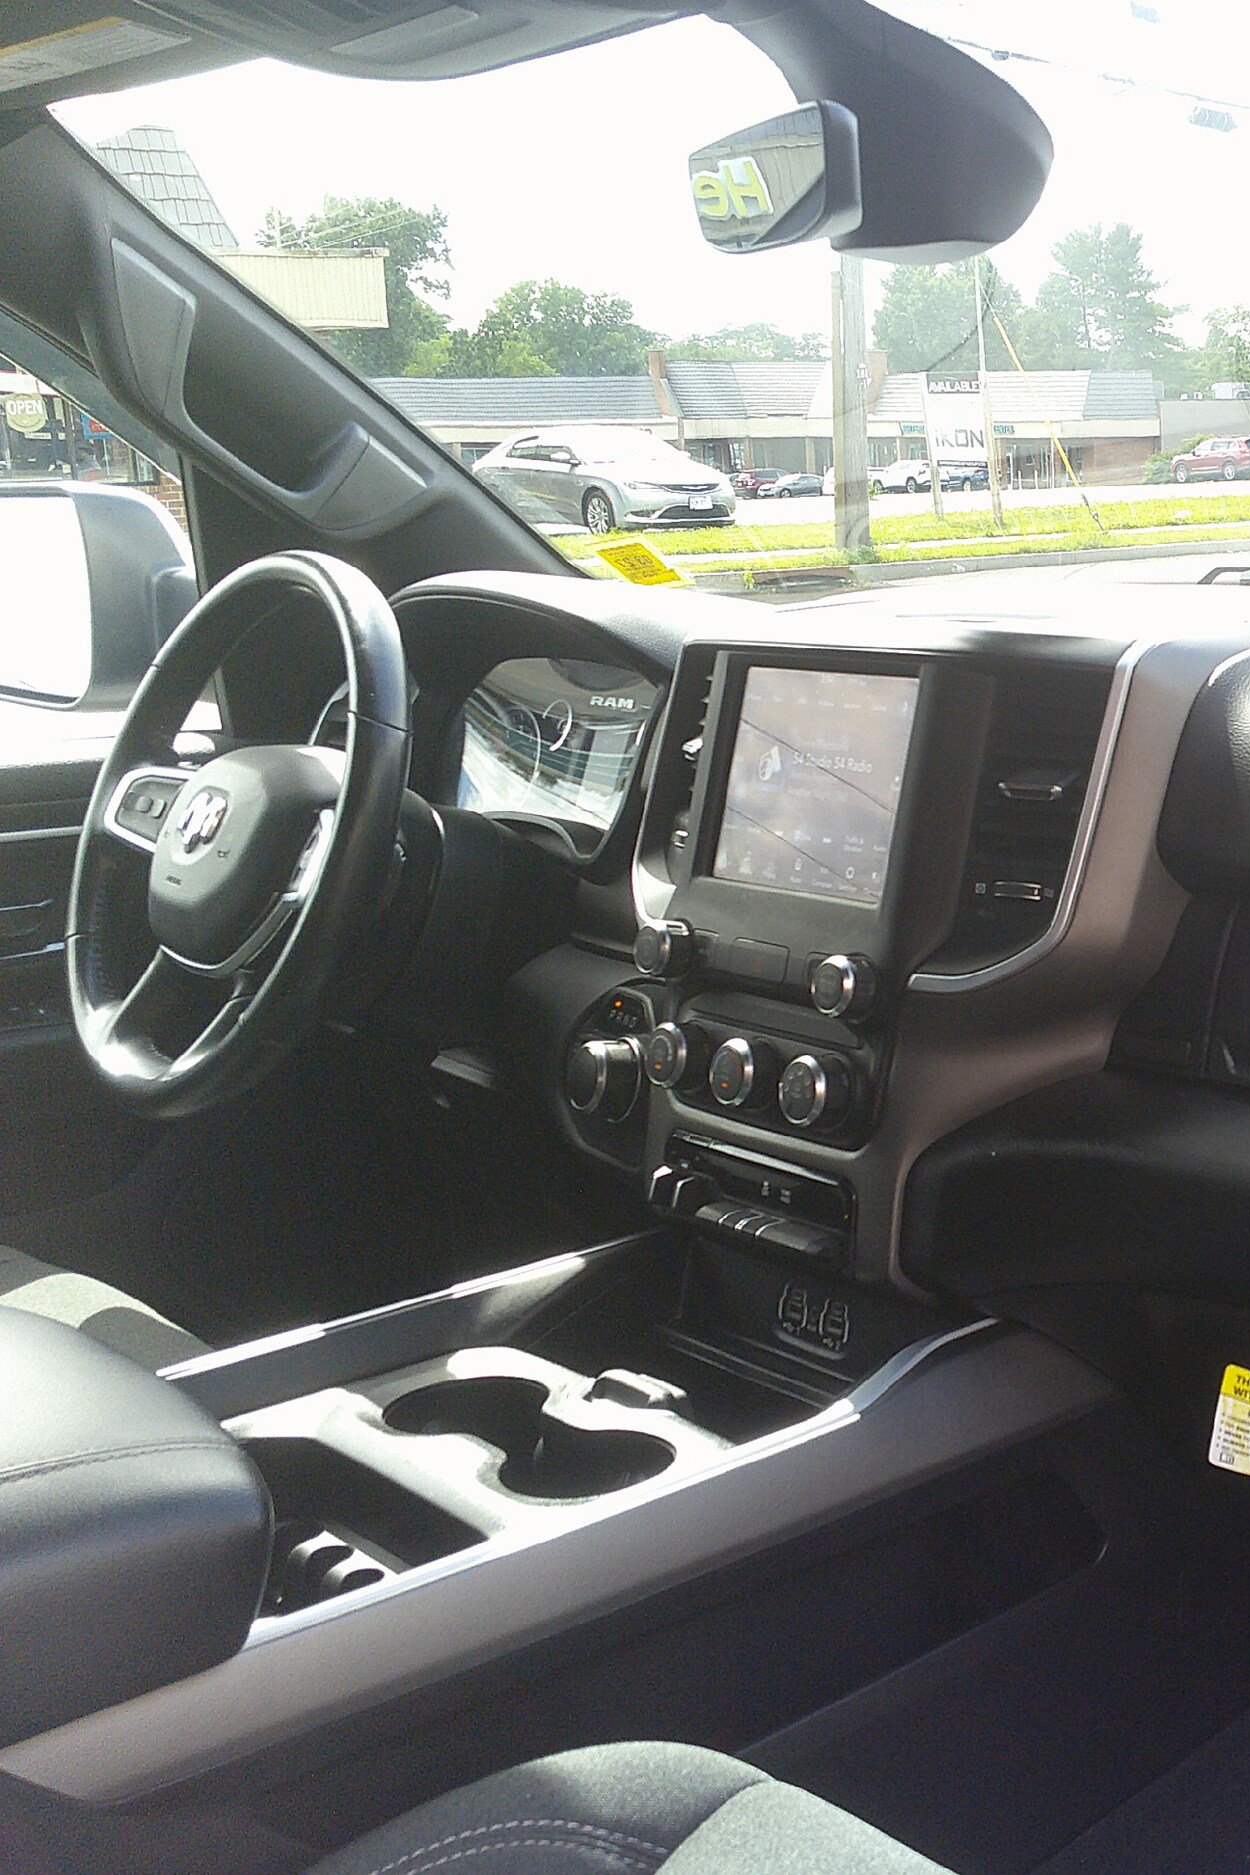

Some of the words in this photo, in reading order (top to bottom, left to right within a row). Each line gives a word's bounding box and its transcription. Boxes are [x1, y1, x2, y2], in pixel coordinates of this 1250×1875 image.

[928, 380, 980, 393] AVAILABLE
[7, 400, 43, 416] OPEN
[590, 695, 634, 709] RAM
